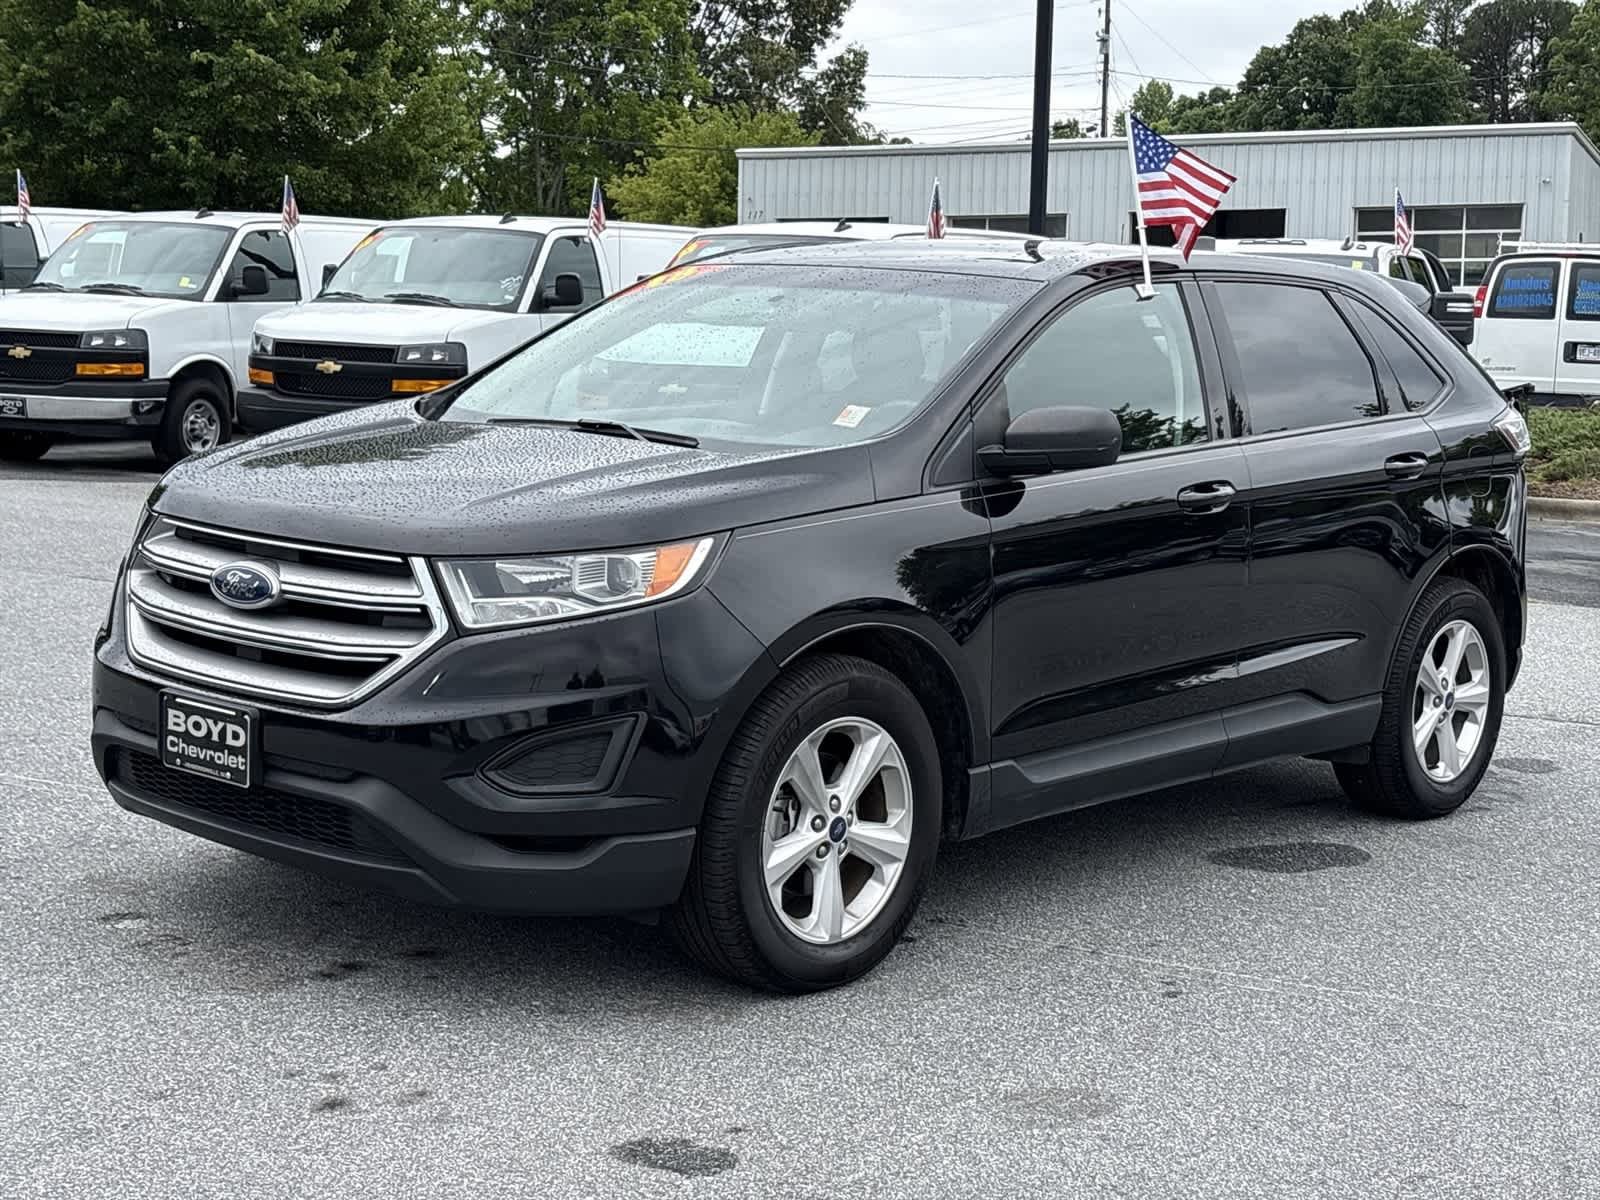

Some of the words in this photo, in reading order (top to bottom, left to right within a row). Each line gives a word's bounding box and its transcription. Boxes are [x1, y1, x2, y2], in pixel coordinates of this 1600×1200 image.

[221, 570, 259, 598] Ford
[167, 708, 246, 747] BOYD
[166, 735, 246, 770] Chevrolet
